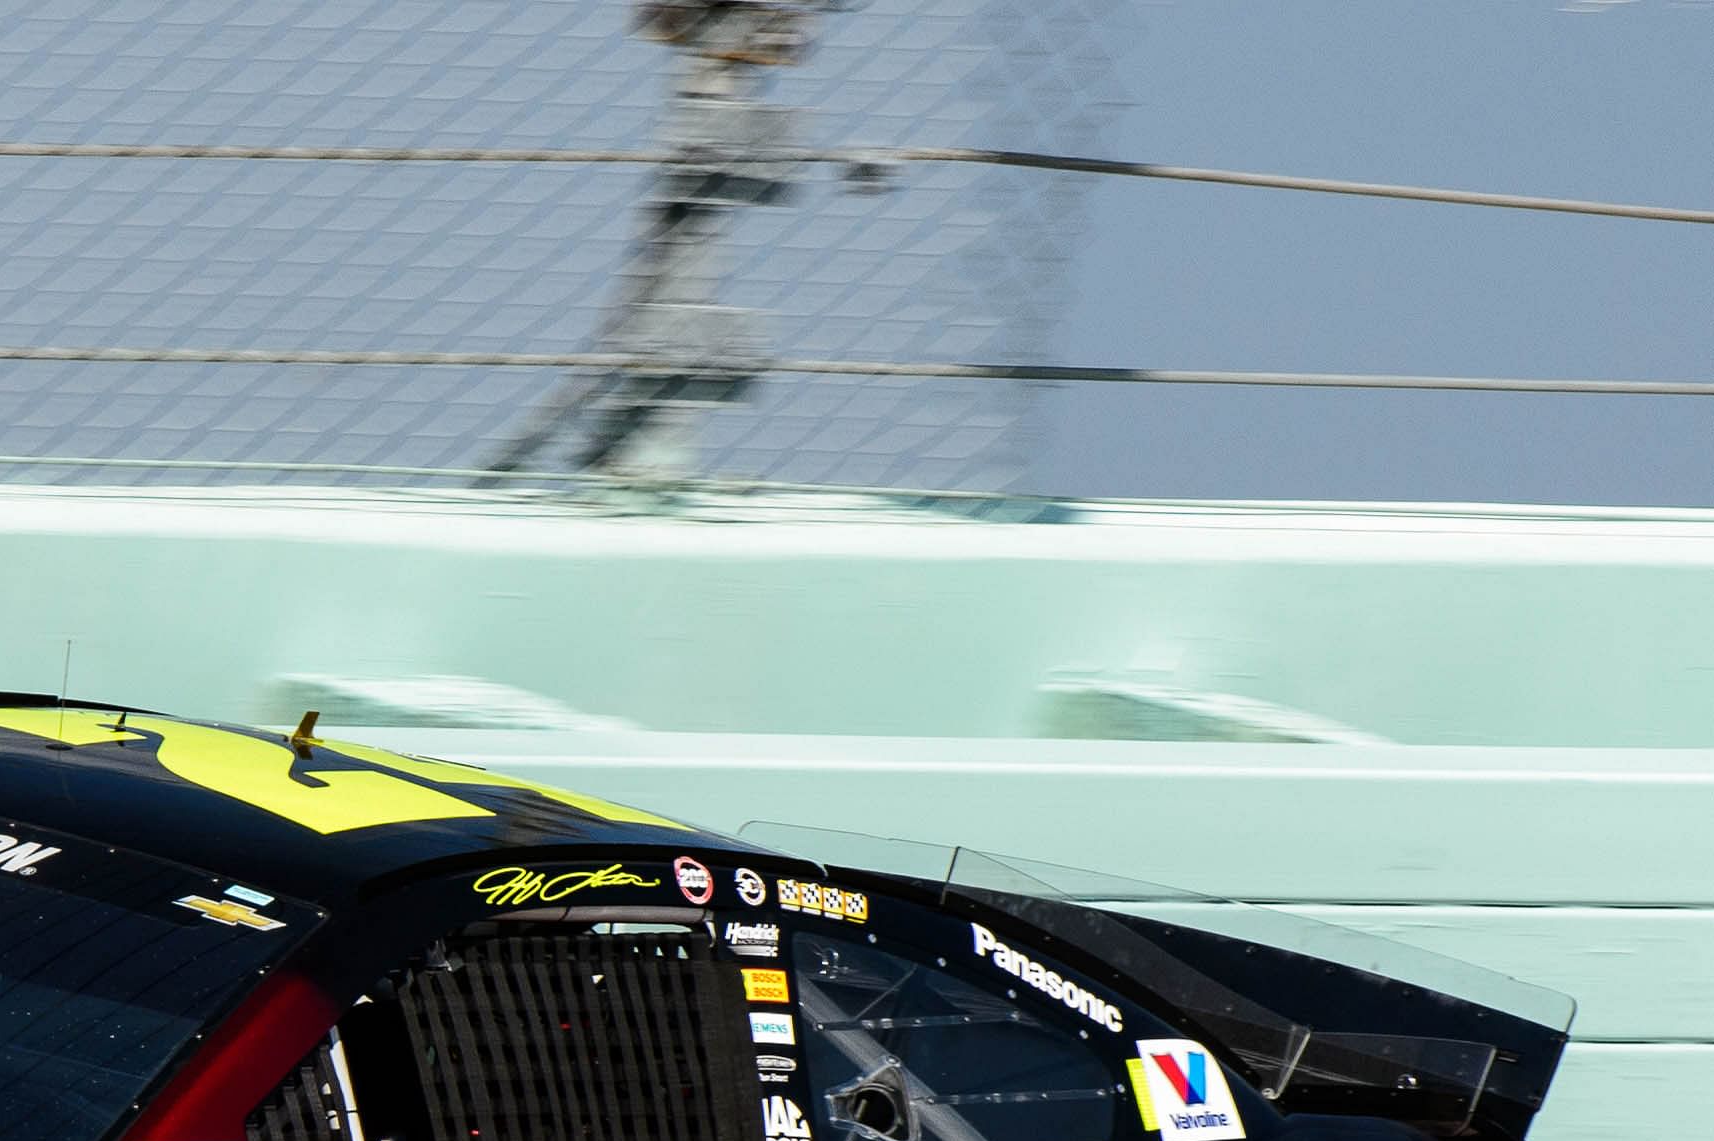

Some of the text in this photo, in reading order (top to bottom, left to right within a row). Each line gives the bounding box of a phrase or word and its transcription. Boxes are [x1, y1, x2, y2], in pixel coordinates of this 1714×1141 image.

[751, 973, 782, 984] BOSCH
[970, 921, 1124, 1033] Panasonic
[753, 987, 784, 998] BOSCH
[1169, 1111, 1230, 1130] Valvoline
